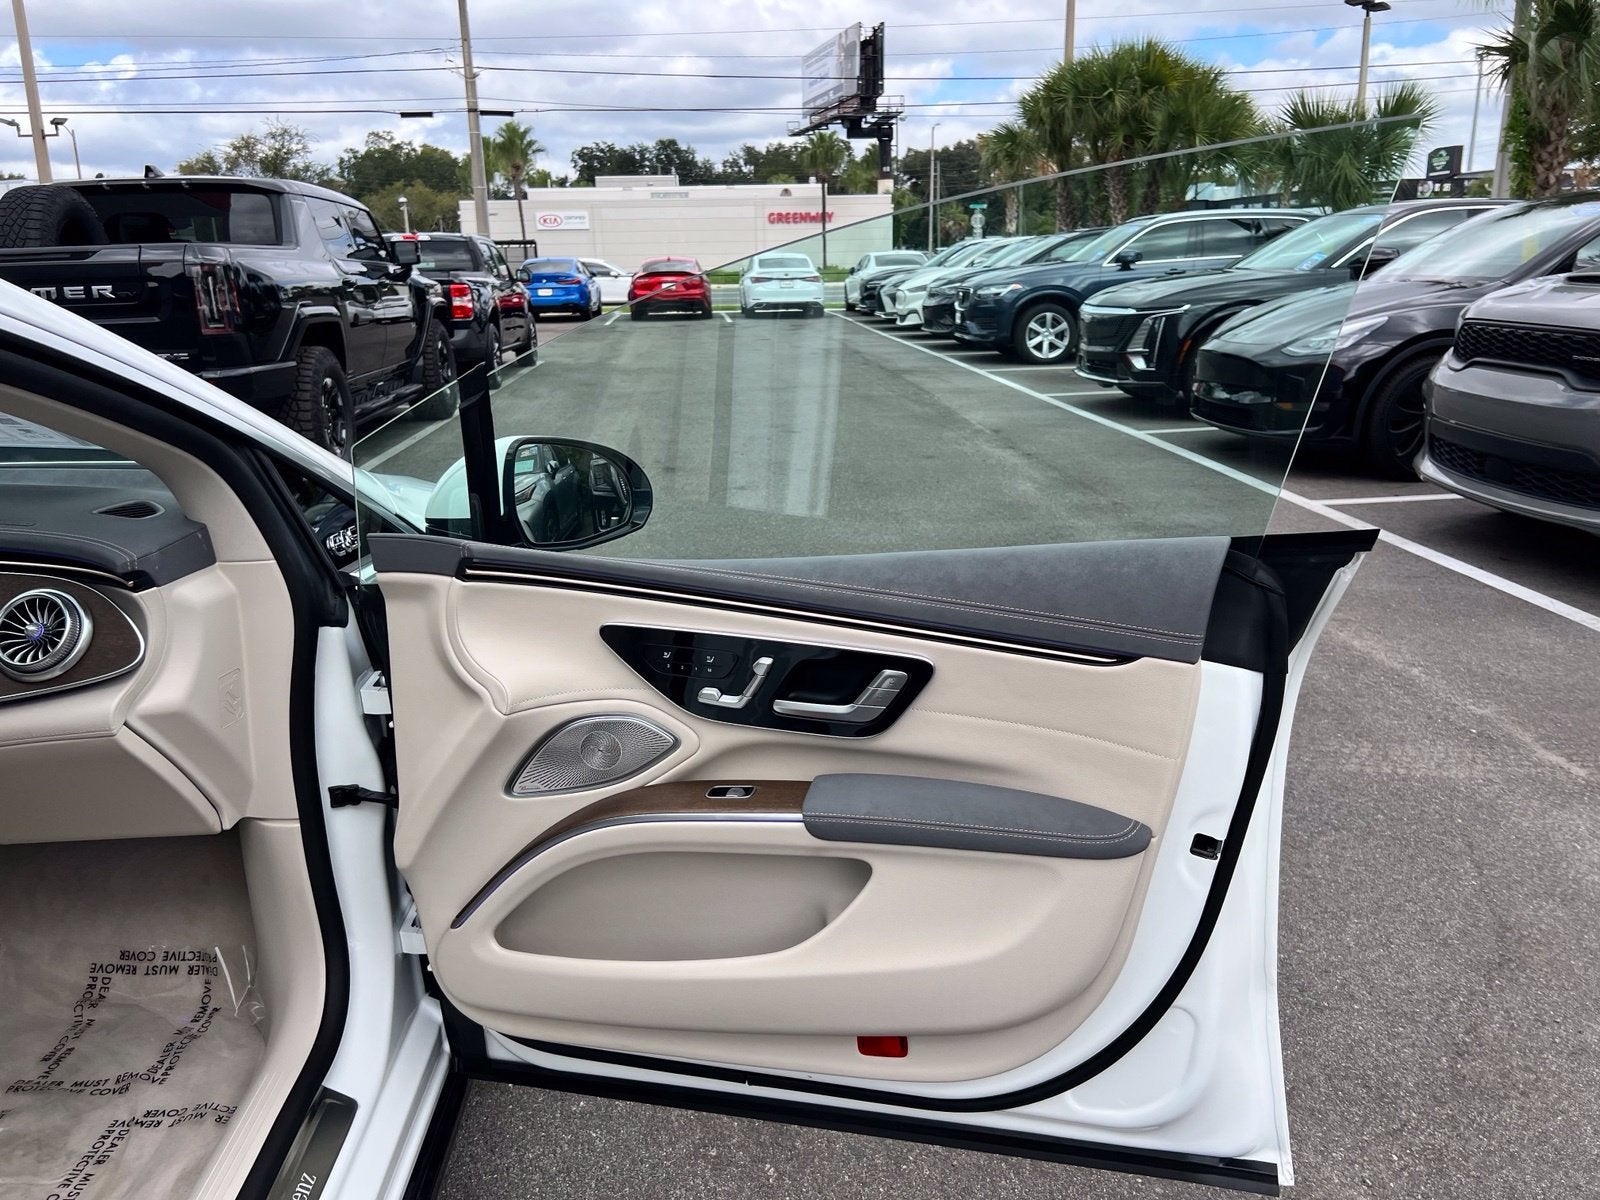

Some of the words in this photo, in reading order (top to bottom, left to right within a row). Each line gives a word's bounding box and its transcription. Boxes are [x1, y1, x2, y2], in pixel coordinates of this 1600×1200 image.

[119, 950, 156, 962] COVER
[90, 963, 137, 976] REMOVE
[144, 965, 179, 976] MUST
[88, 977, 112, 1009] DEAR
[147, 1041, 176, 1074] DEALER
[191, 979, 212, 1022] REMOVE
[71, 1079, 110, 1087] MUST
[115, 1072, 169, 1085] REMOVE
[5, 1085, 86, 1094] PROTECVE
[90, 1083, 131, 1095] COVER
[143, 1107, 188, 1118] COVER
[168, 1111, 207, 1127] MUST
[92, 1129, 130, 1165] DEALER
[57, 1129, 116, 1188] PROTECTIVE
